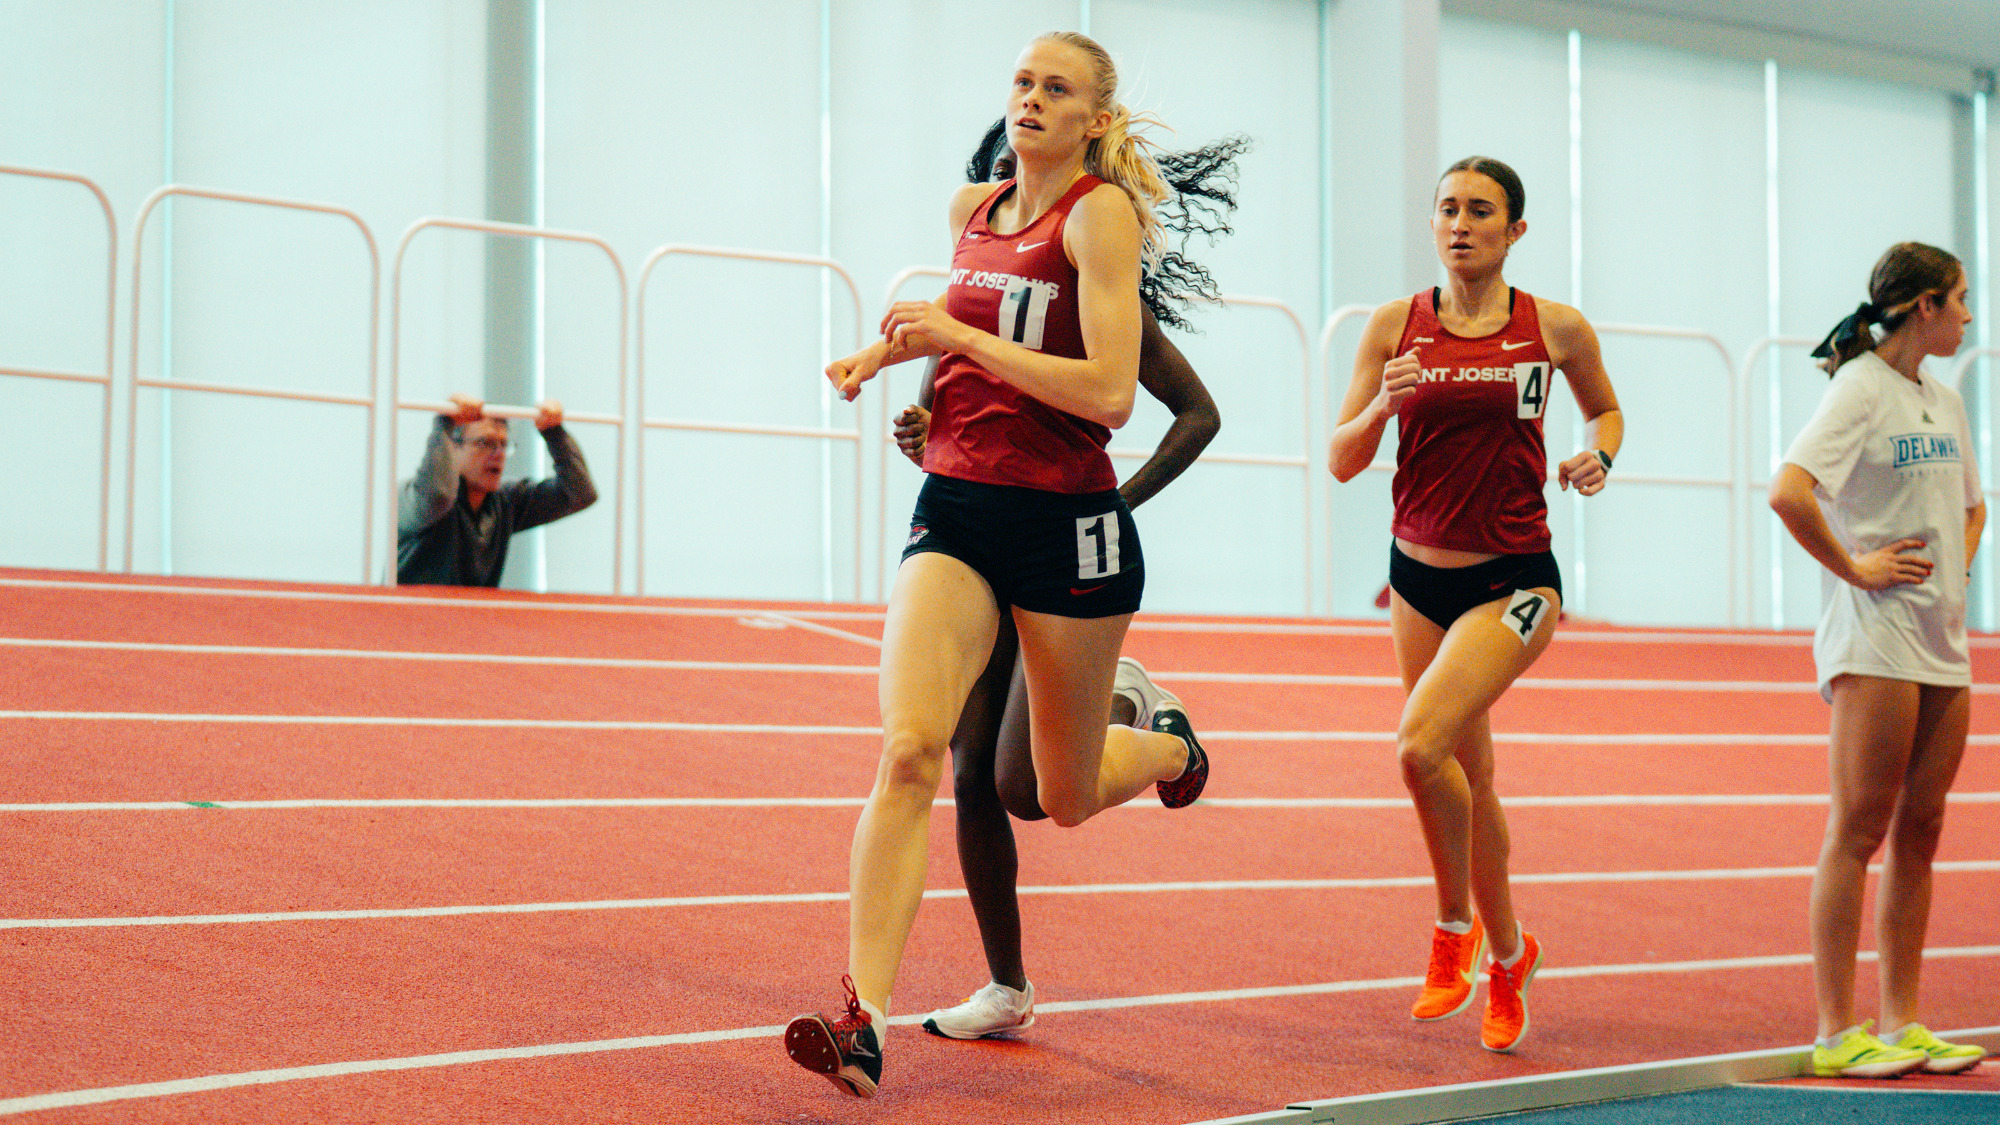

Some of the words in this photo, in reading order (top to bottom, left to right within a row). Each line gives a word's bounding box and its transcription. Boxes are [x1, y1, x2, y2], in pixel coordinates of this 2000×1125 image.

[966, 270, 1060, 300] JOSE'S
[1010, 286, 1032, 343] 1
[1417, 367, 1450, 383] NT
[1522, 366, 1543, 414] 4
[1085, 516, 1108, 573] 1
[1510, 596, 1543, 635] 4
